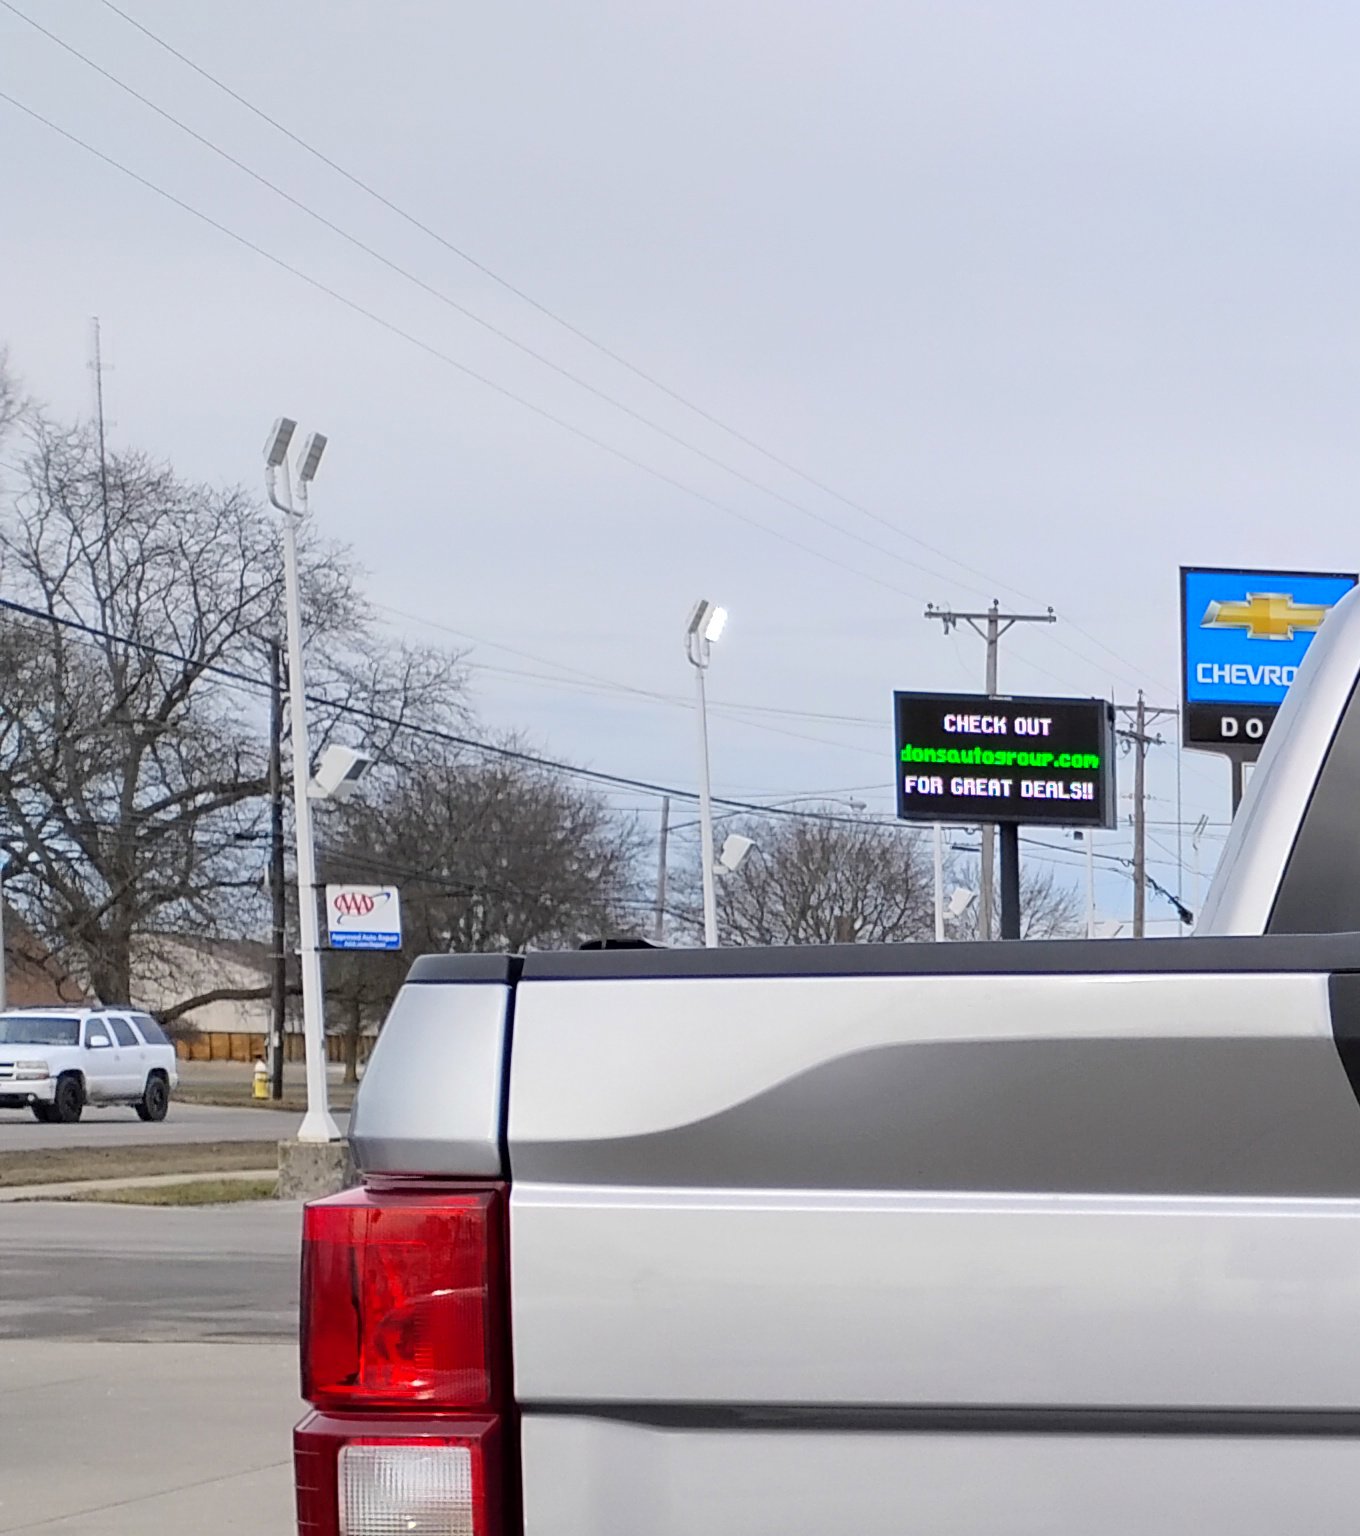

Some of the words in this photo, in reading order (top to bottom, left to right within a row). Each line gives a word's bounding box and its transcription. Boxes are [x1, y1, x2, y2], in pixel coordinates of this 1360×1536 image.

[943, 714, 1007, 735] CHECK
[1014, 717, 1052, 736] OUT
[901, 744, 1099, 768] donsautogroup.com
[905, 776, 943, 794] FOR
[951, 777, 1012, 796] GREAT
[1021, 780, 1094, 800] DEALS!!
[335, 892, 373, 916] AAA
